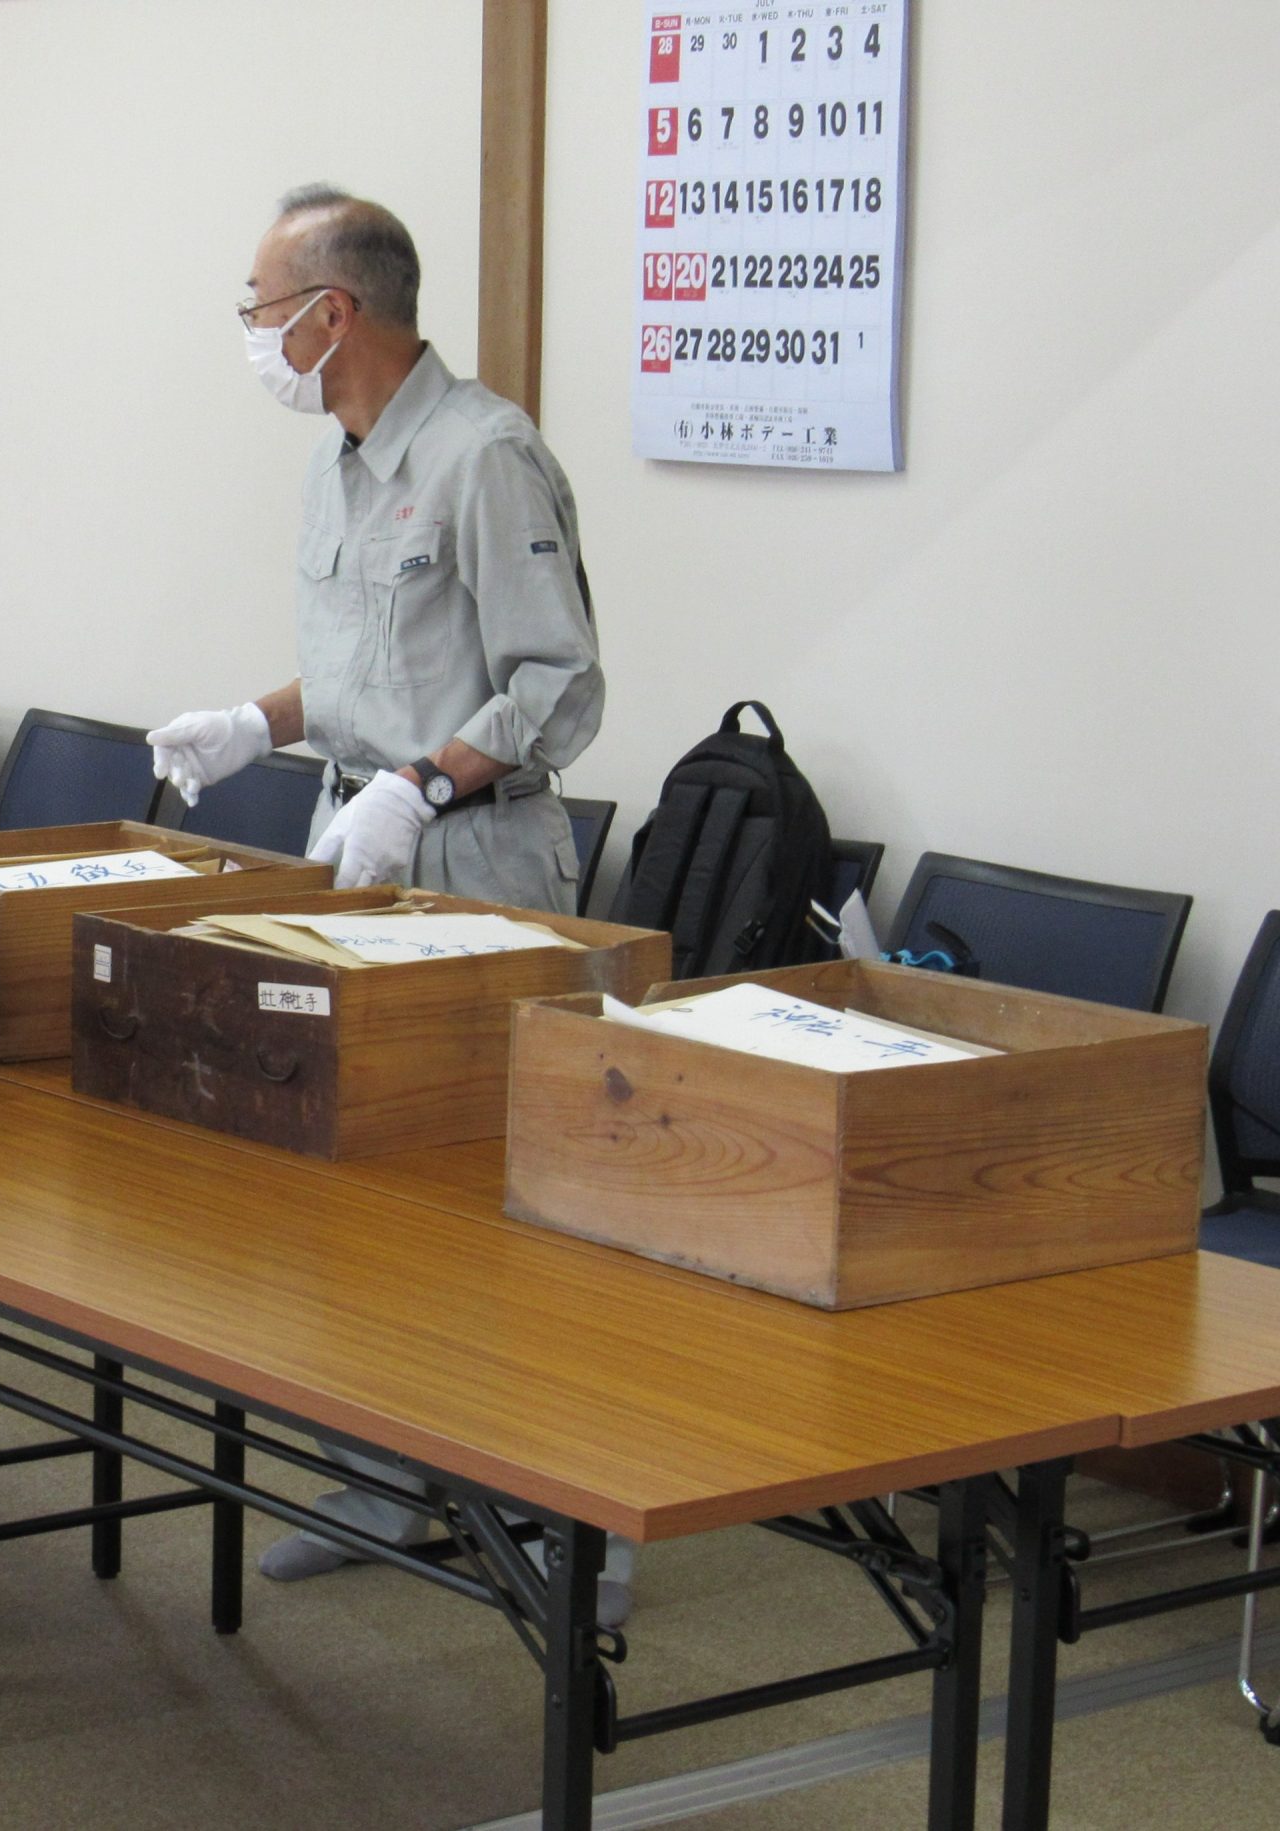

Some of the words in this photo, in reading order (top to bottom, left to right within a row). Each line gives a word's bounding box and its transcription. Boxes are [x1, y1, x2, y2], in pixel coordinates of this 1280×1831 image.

[657, 36, 673, 55] 28
[690, 34, 705, 52] 29
[722, 32, 737, 50] 30
[759, 30, 768, 63] 1
[791, 28, 806, 62] 2
[827, 25, 843, 60] 3
[863, 23, 881, 58] 4
[656, 109, 672, 143] 5
[687, 107, 702, 141] 6
[721, 107, 735, 140] 7
[753, 104, 769, 139] 8
[788, 103, 804, 138] 9
[817, 101, 847, 137] 10
[857, 100, 882, 135] 11
[646, 181, 674, 216] 12
[679, 180, 706, 215] 13
[712, 180, 739, 214] 14
[746, 179, 773, 214] 15
[780, 178, 809, 214] 16
[815, 178, 845, 213] 17
[851, 177, 882, 213] 18
[644, 254, 672, 288] 19
[675, 254, 706, 289] 20
[711, 254, 738, 288] 21
[743, 254, 773, 289] 22
[777, 254, 808, 289] 23
[813, 254, 845, 289] 24
[849, 254, 880, 289] 25
[642, 326, 670, 361] 26
[674, 327, 703, 361] 27
[706, 328, 736, 363] 28
[740, 328, 771, 364] 29
[774, 328, 806, 364] 30
[811, 329, 840, 365] 31
[858, 331, 864, 349] 1
